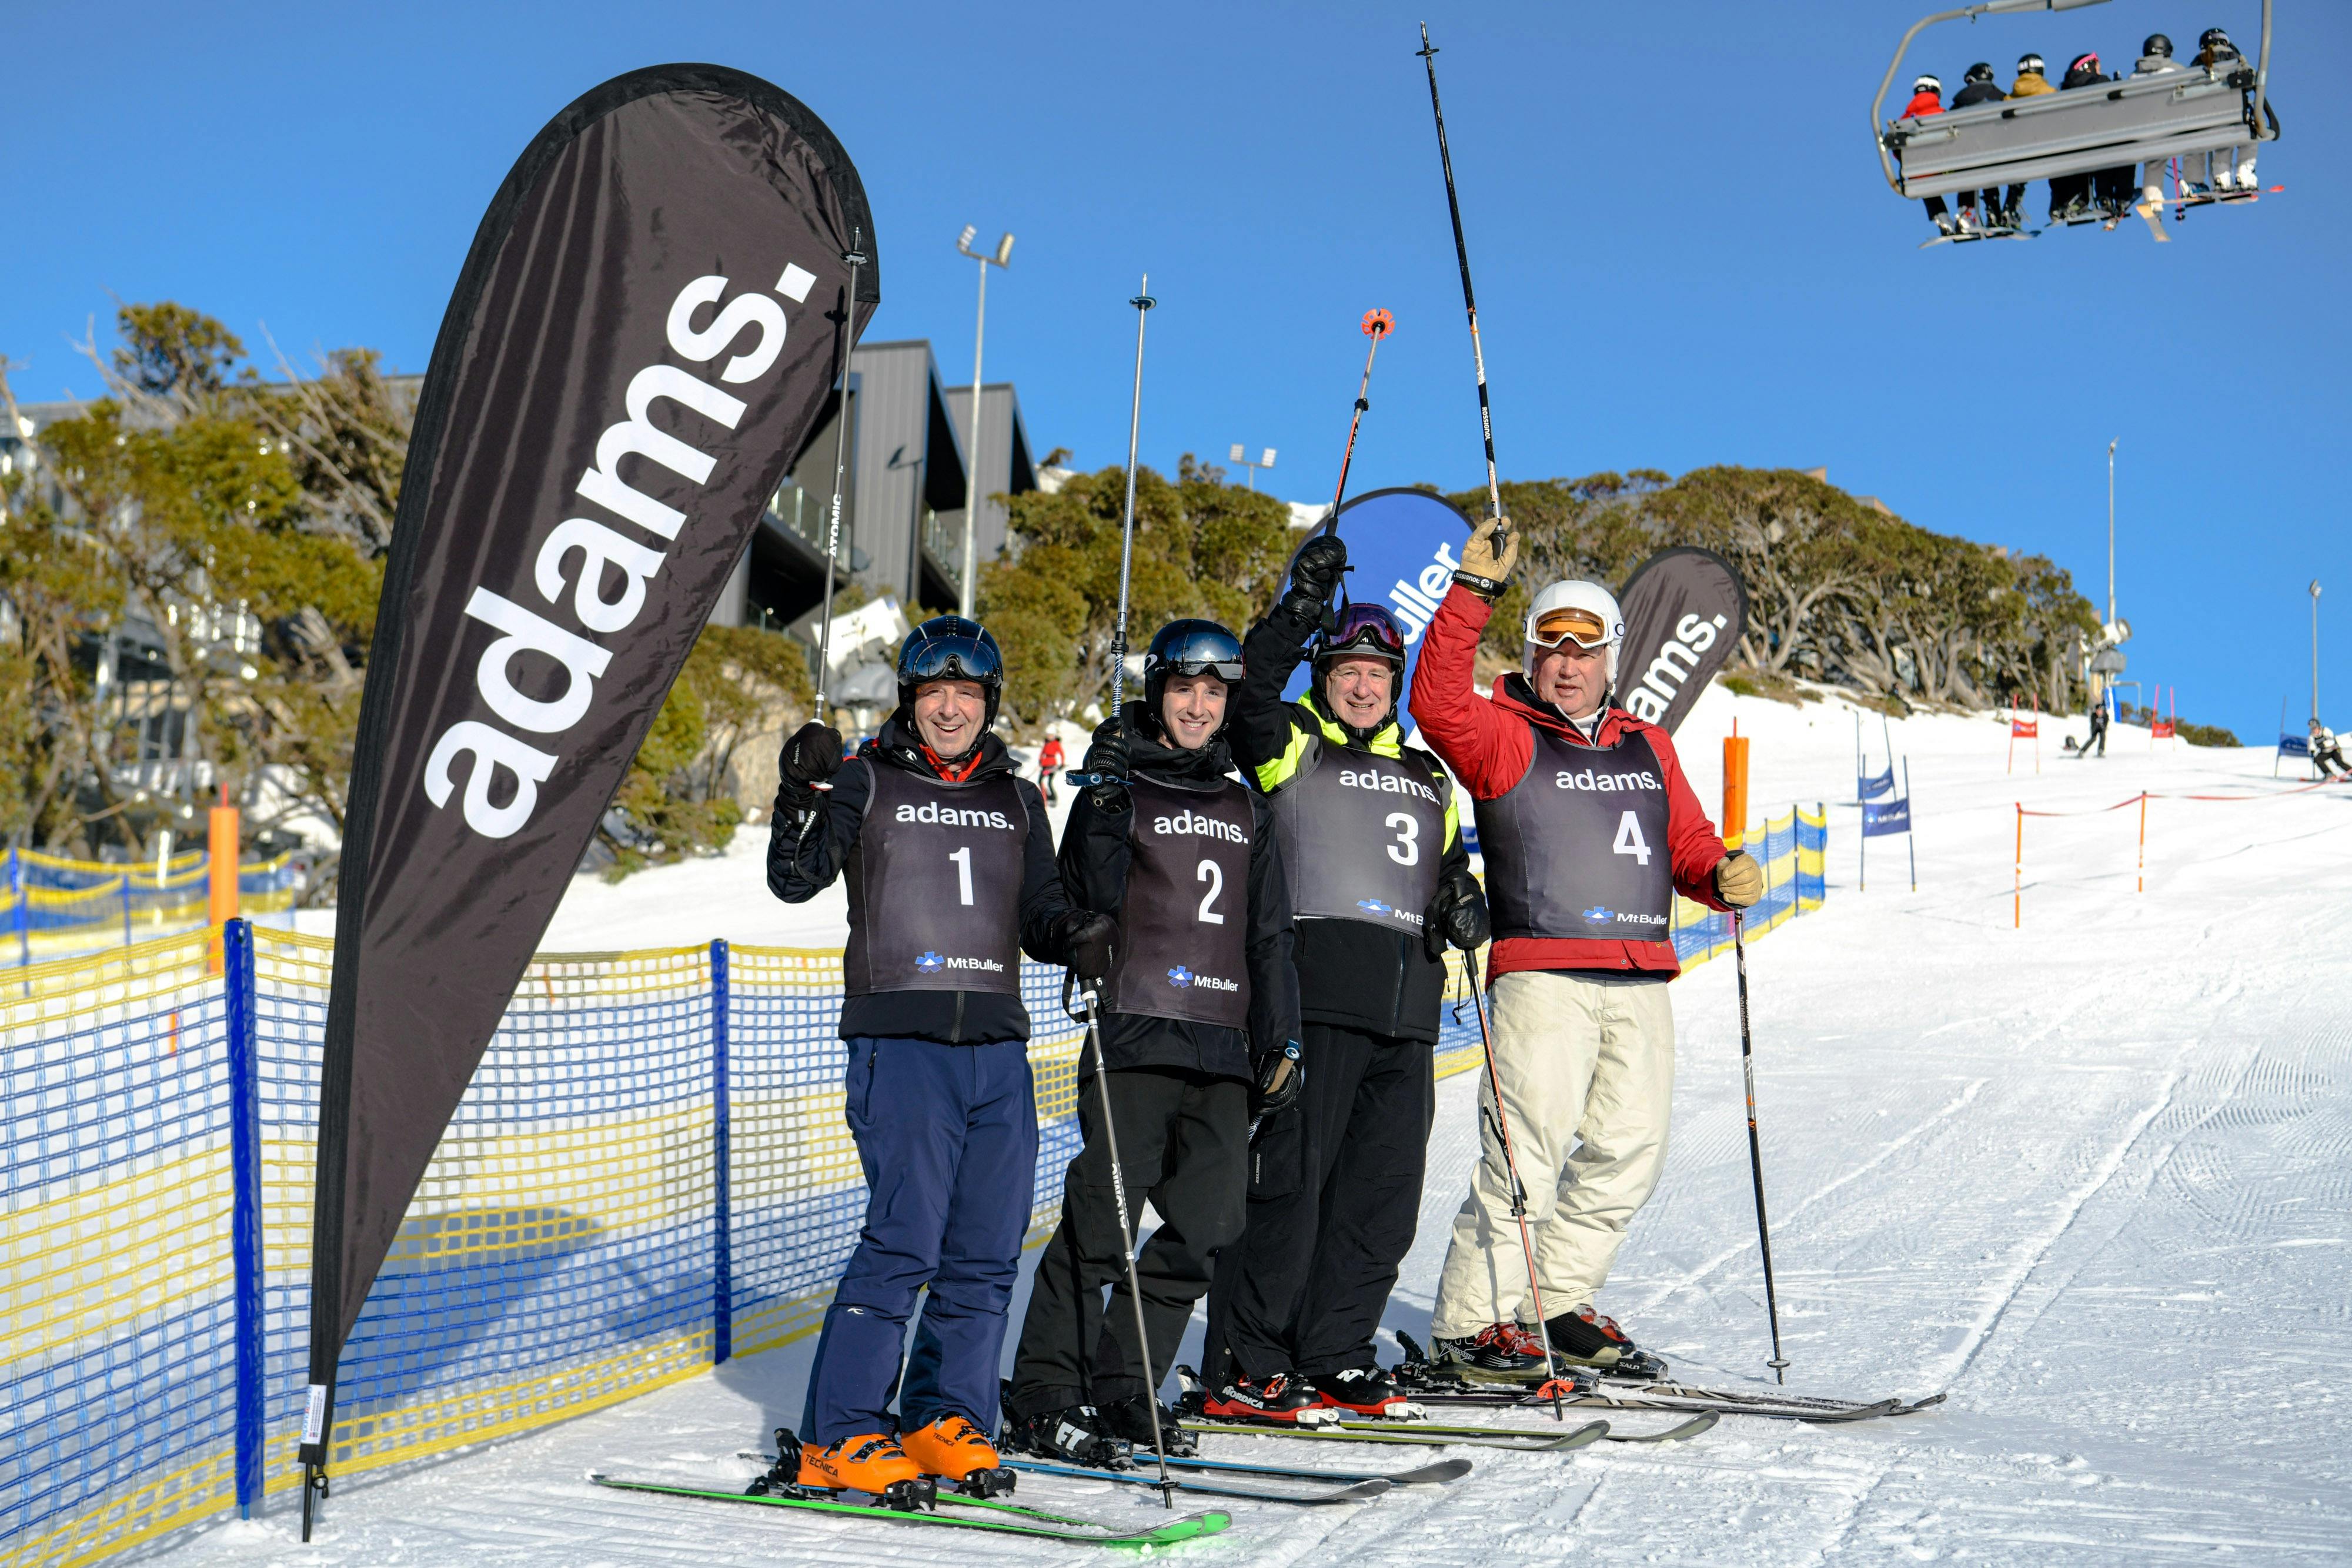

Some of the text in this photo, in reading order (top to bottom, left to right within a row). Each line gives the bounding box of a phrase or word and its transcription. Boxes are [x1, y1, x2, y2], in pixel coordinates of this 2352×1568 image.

[424, 262, 817, 839] adams.
[829, 493, 841, 558] ATOMIC
[1389, 541, 1461, 645] uller
[1626, 613, 1728, 725] ams.
[1339, 770, 1440, 805] adams.
[1556, 769, 1662, 791] adams.
[896, 801, 1014, 830] adams.
[1154, 809, 1248, 844] adams.
[1385, 812, 1419, 866] 3
[1612, 810, 1652, 865] 4
[949, 847, 974, 905] 1
[1197, 859, 1224, 925] 2
[1222, 1385, 1264, 1409] NORDICA
[1055, 1421, 1090, 1452] FT
[805, 1454, 838, 1477] TECNICA
